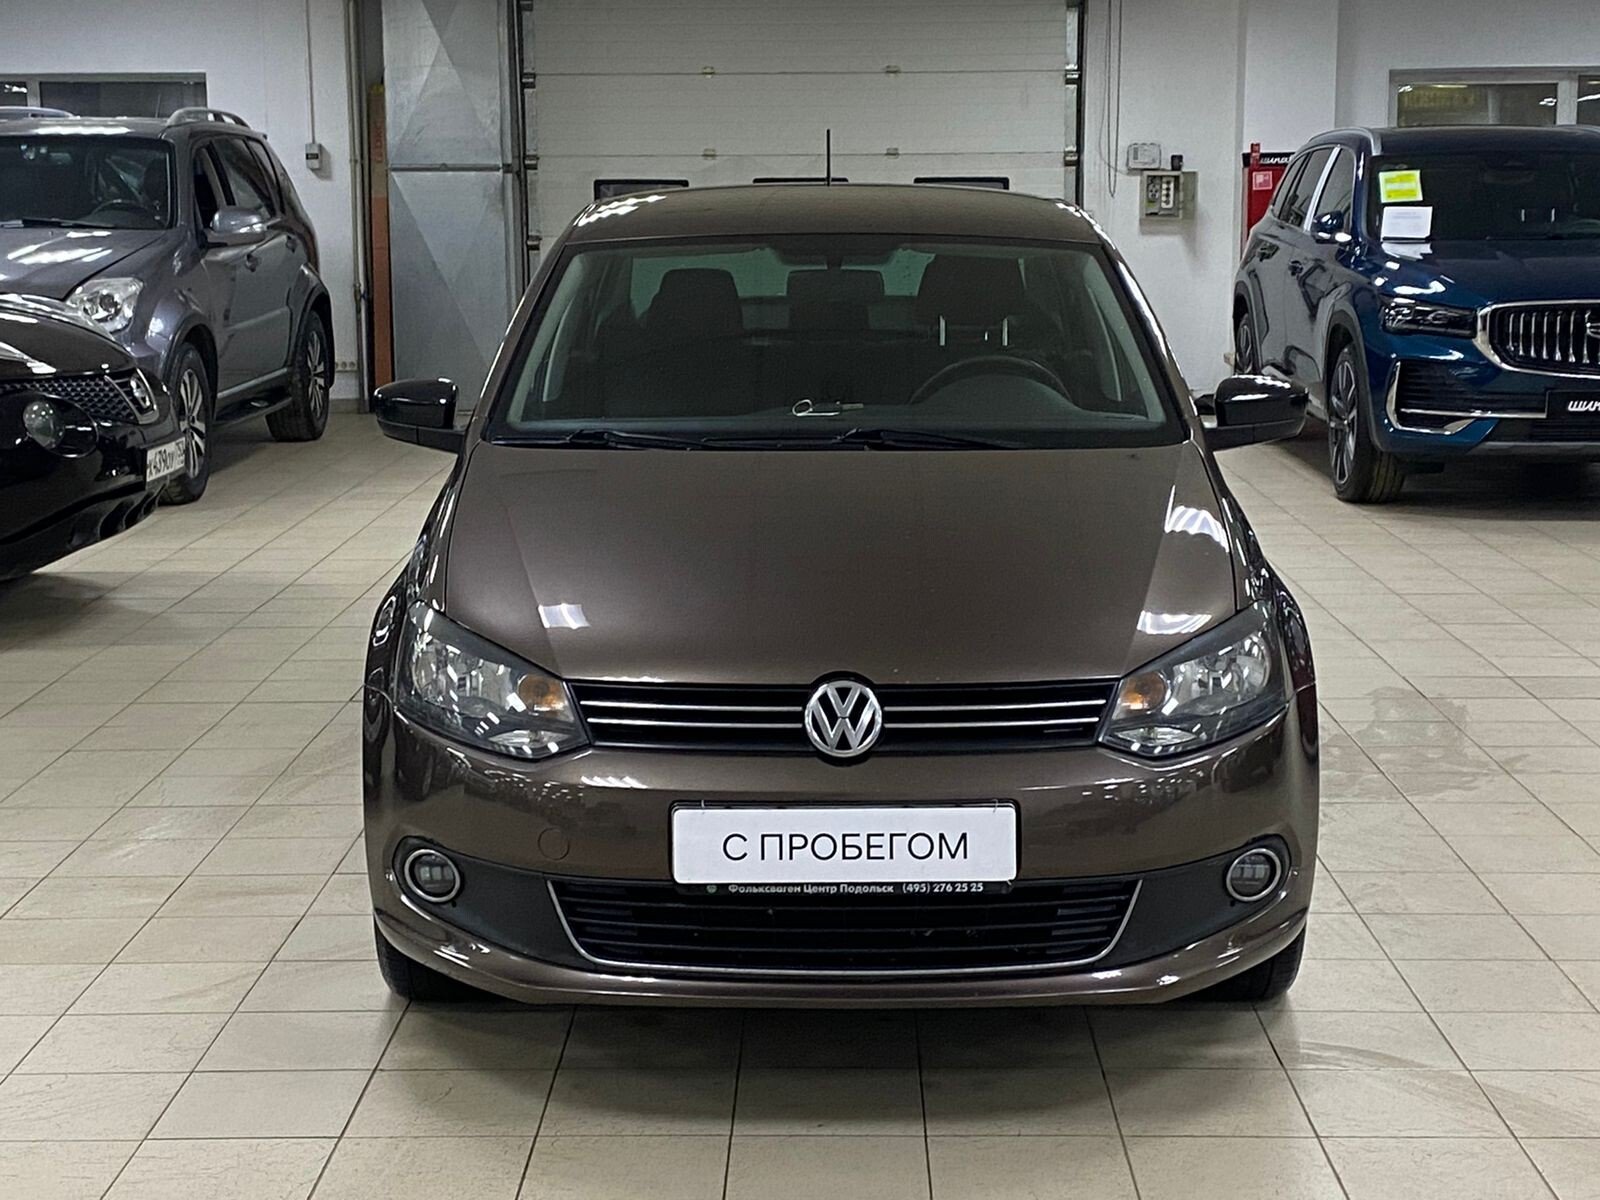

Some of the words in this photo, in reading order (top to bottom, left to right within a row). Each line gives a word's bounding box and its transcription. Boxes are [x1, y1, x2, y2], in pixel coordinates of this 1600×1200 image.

[806, 681, 882, 756] VW
[722, 833, 748, 862] С
[760, 832, 968, 861] ПРОБЕГОМ
[803, 884, 838, 895] Центр
[840, 883, 894, 894] Подольск
[902, 882, 931, 894] (495)
[933, 882, 953, 893] 276
[955, 882, 968, 893] 25
[970, 882, 984, 892] 25
